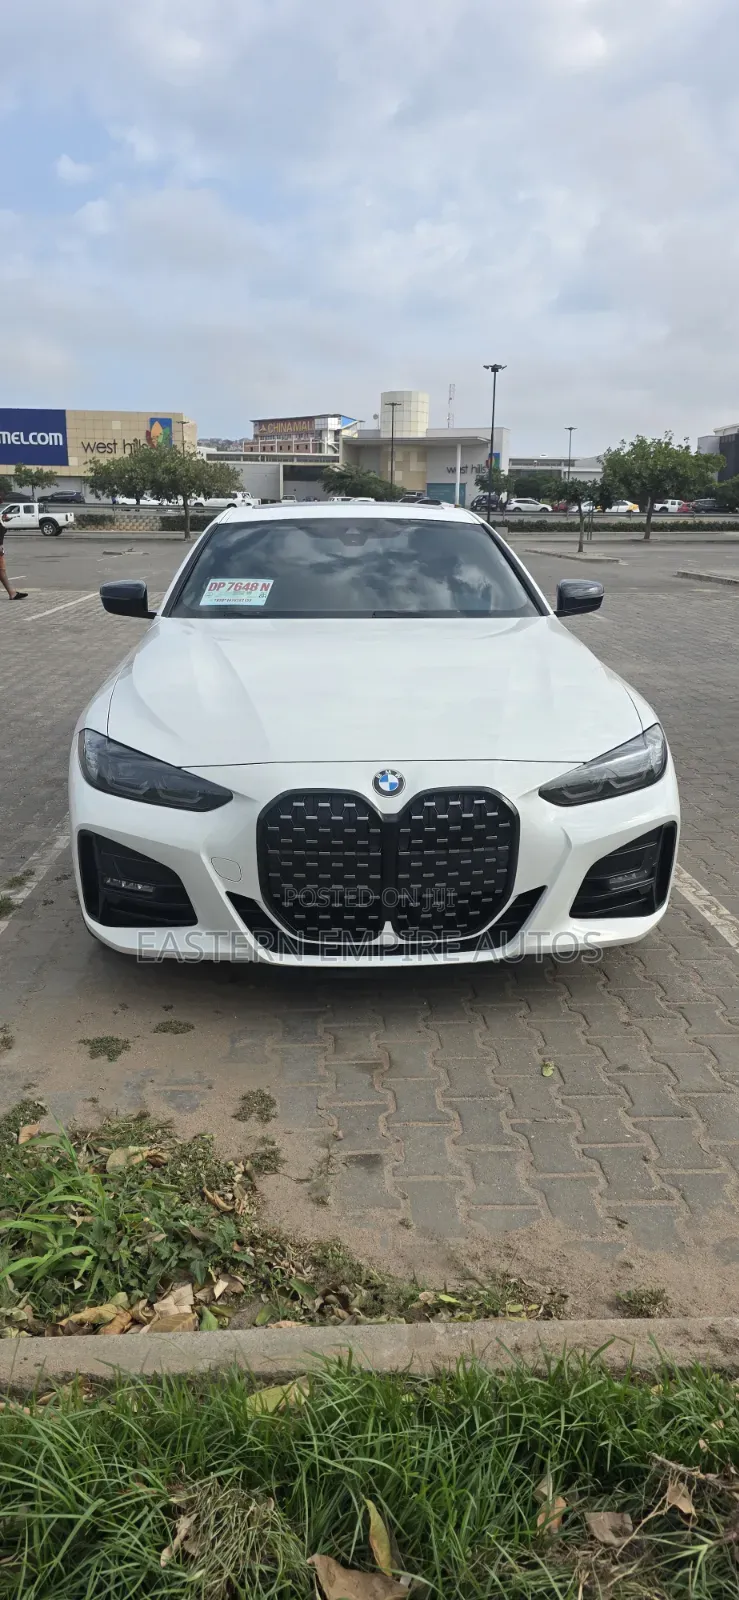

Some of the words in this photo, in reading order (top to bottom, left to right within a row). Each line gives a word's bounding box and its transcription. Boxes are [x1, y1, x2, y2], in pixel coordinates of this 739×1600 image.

[267, 421, 293, 433] CHINA
[81, 439, 118, 454] west
[471, 463, 486, 474] hills
[208, 582, 226, 591] DP
[226, 582, 259, 592] 7648
[260, 582, 271, 592] N
